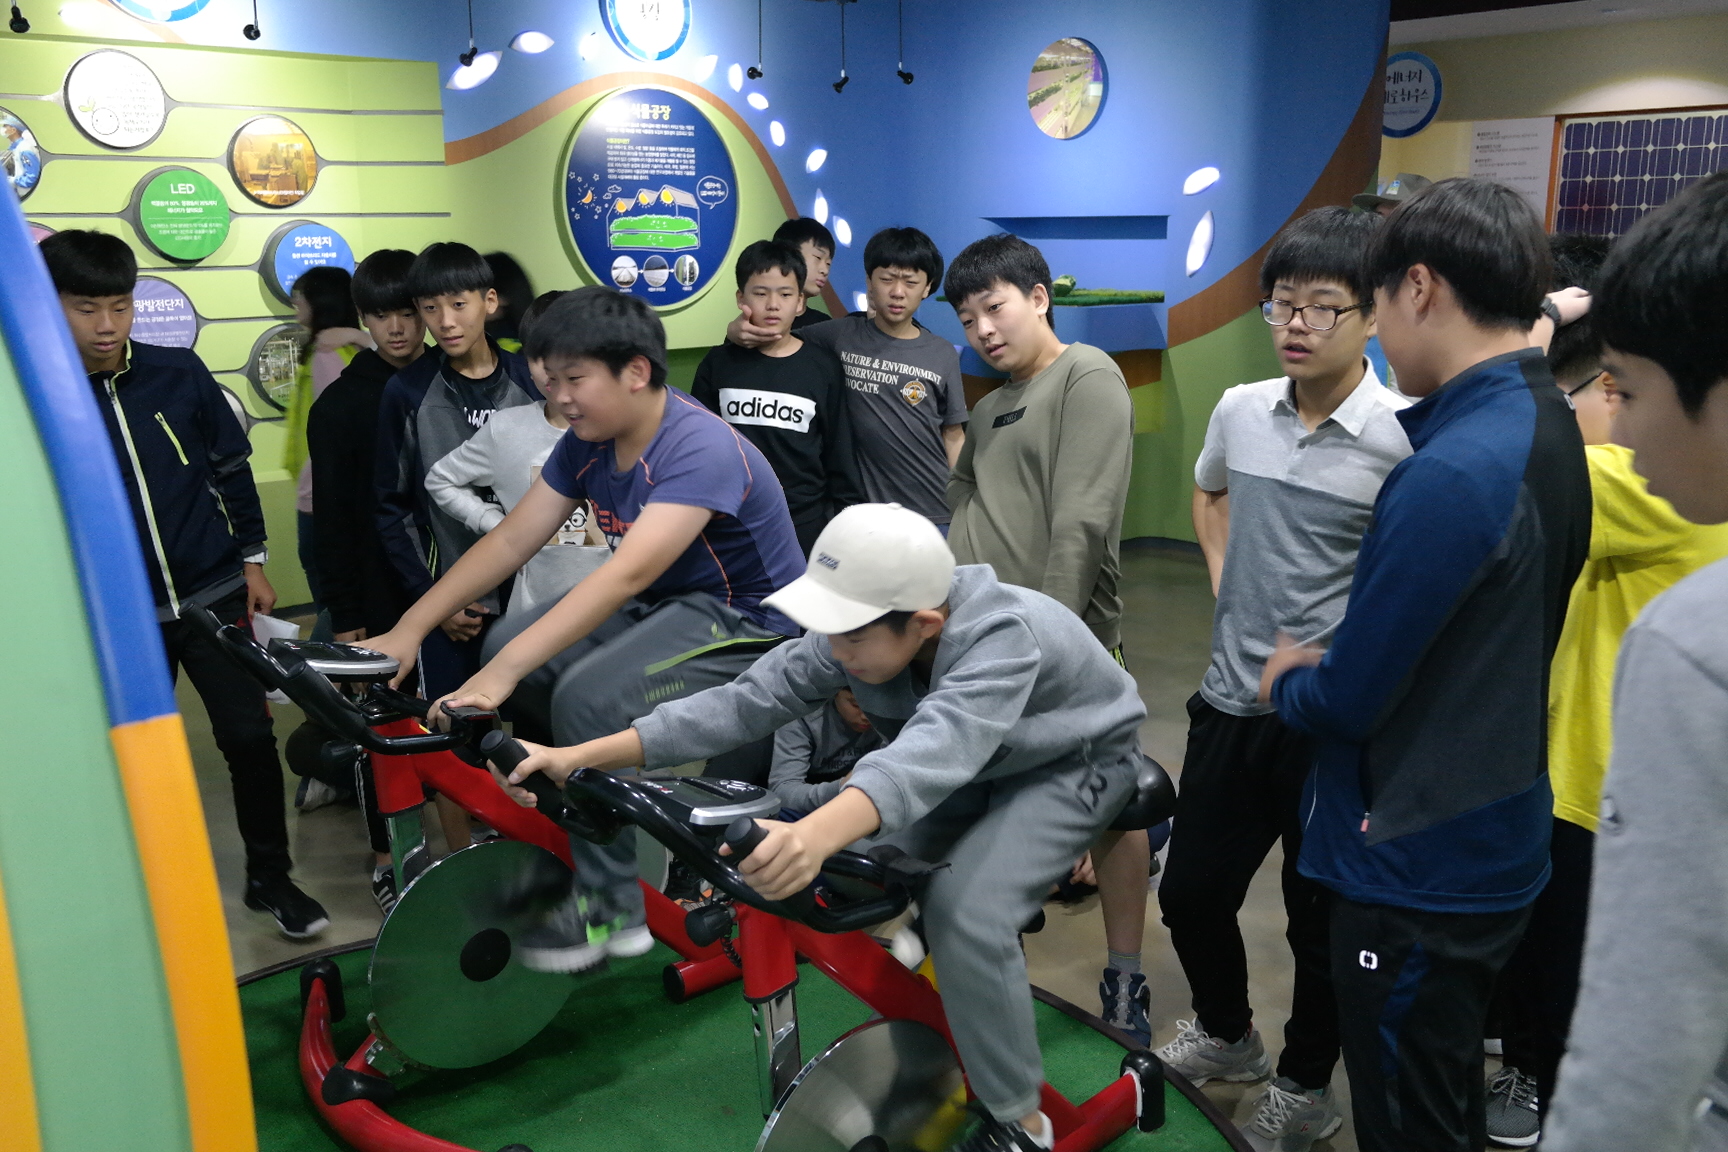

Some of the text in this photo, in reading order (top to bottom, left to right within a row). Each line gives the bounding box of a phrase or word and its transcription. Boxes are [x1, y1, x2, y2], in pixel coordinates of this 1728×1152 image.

[1386, 69, 1422, 85] 에너지
[170, 183, 196, 195] LED
[294, 235, 332, 250] 2차전지
[133, 298, 184, 313] 광발전단지
[840, 350, 942, 385] NATURE & ENVIRONMENT
[842, 363, 899, 385] RESERVATION
[845, 377, 880, 395] VOCATE
[726, 396, 805, 424] adidas
